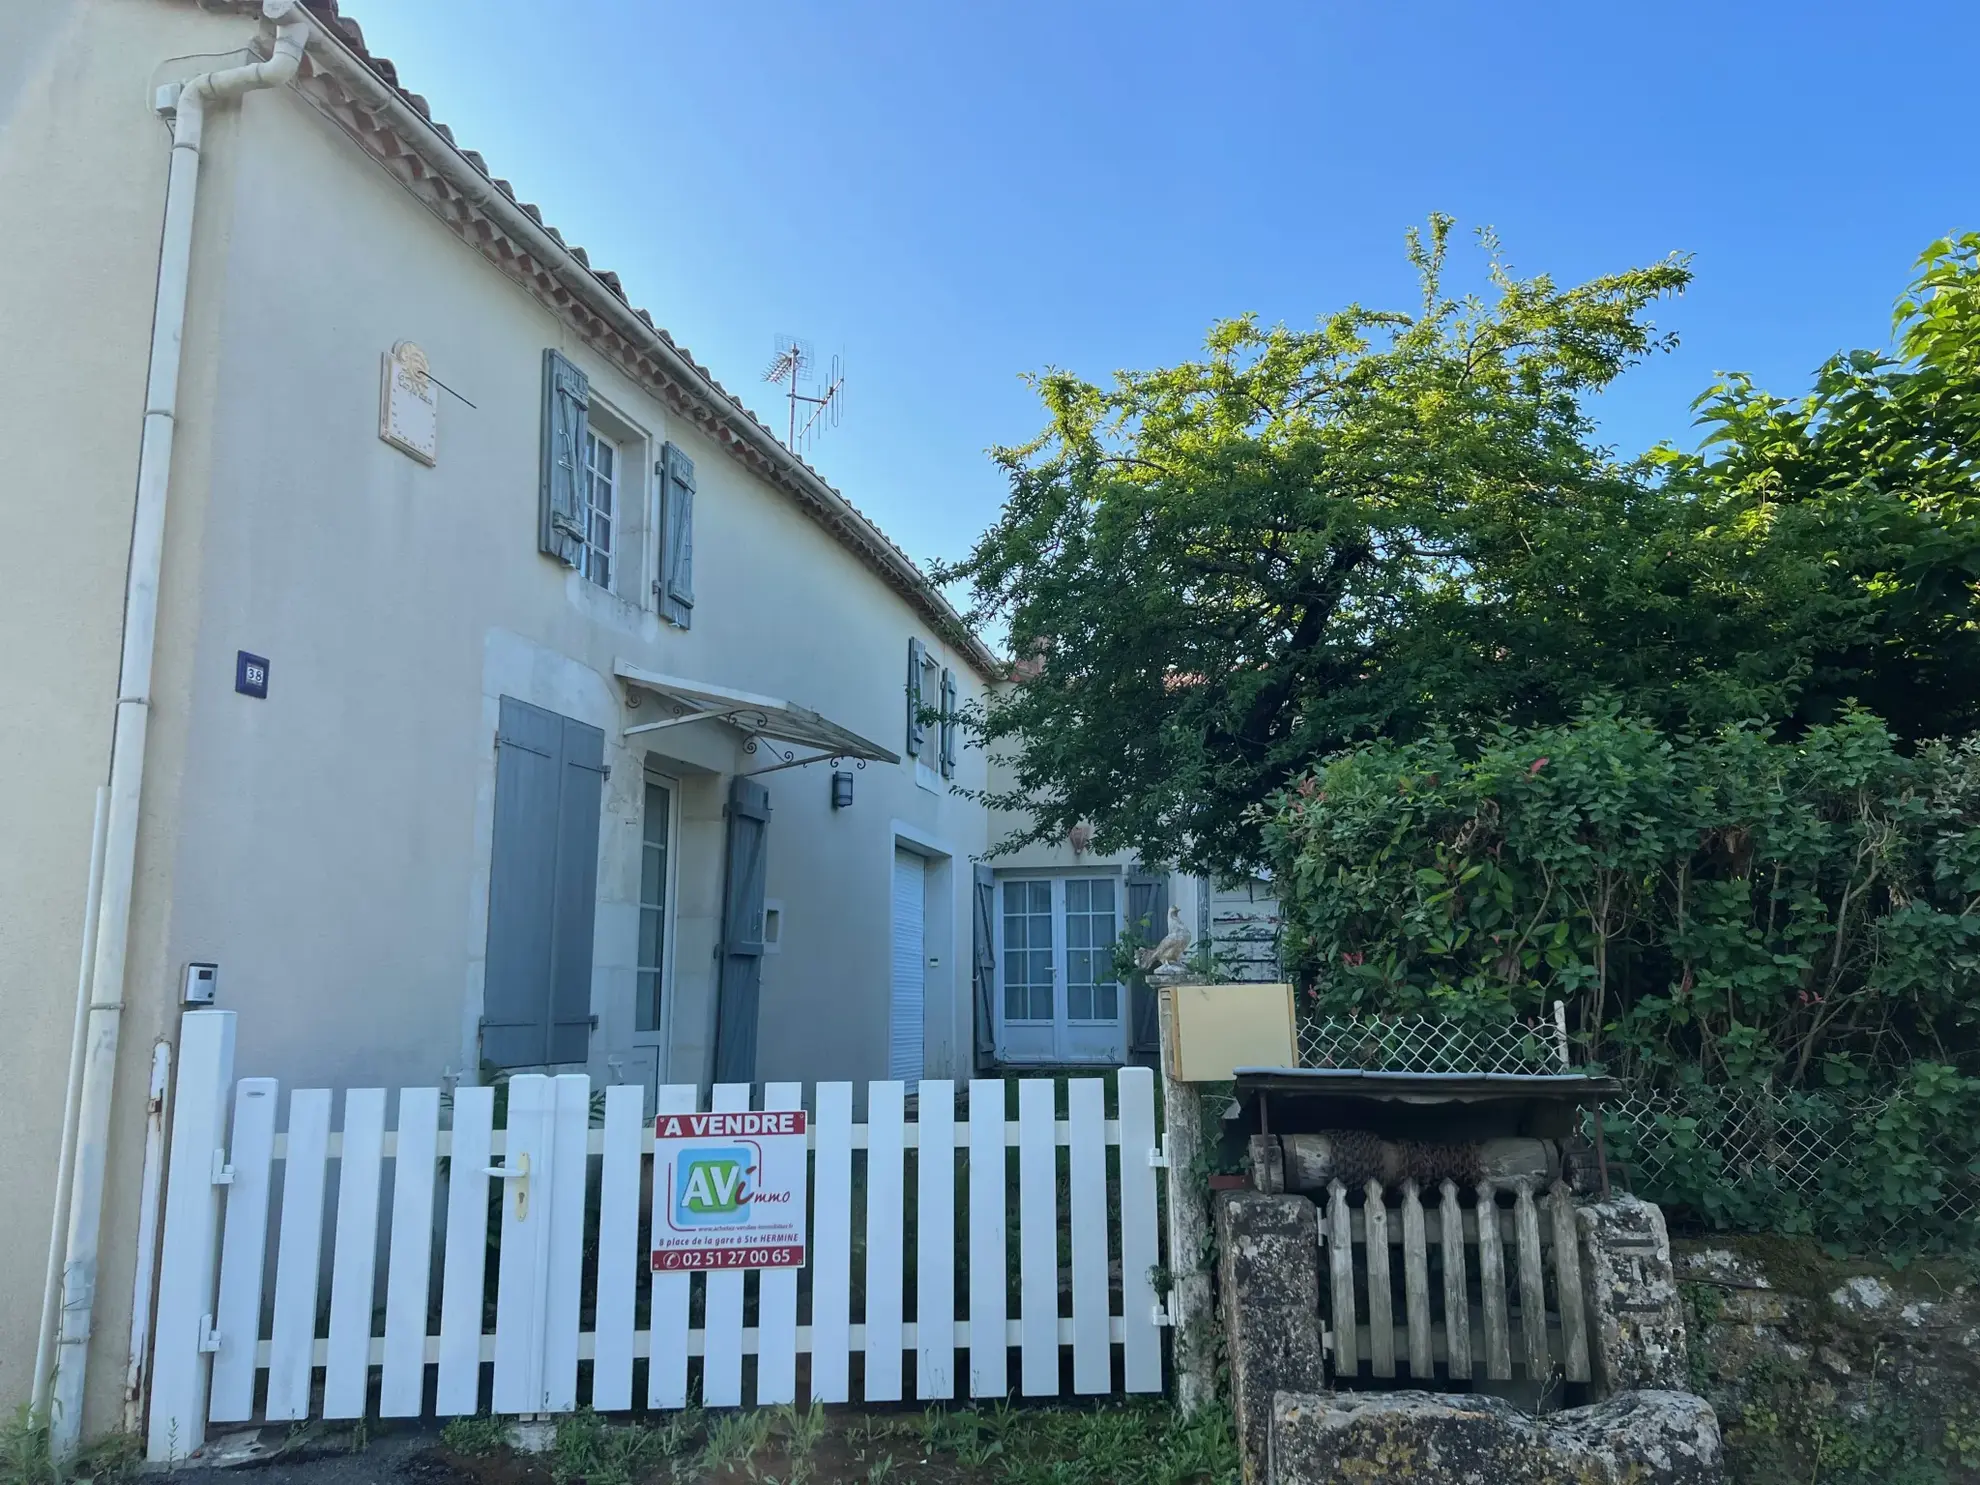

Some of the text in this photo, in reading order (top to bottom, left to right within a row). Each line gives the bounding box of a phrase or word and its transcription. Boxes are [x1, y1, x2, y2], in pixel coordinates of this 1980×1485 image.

[663, 1114, 794, 1136] A VENDRE
[667, 1237, 689, 1247] place
[692, 1237, 702, 1245] de
[705, 1236, 712, 1245] la
[715, 1236, 735, 1246] gare
[744, 1234, 758, 1243] Ste
[760, 1233, 798, 1243] HERMINE
[683, 1249, 790, 1266] 02 51 27 00 65
